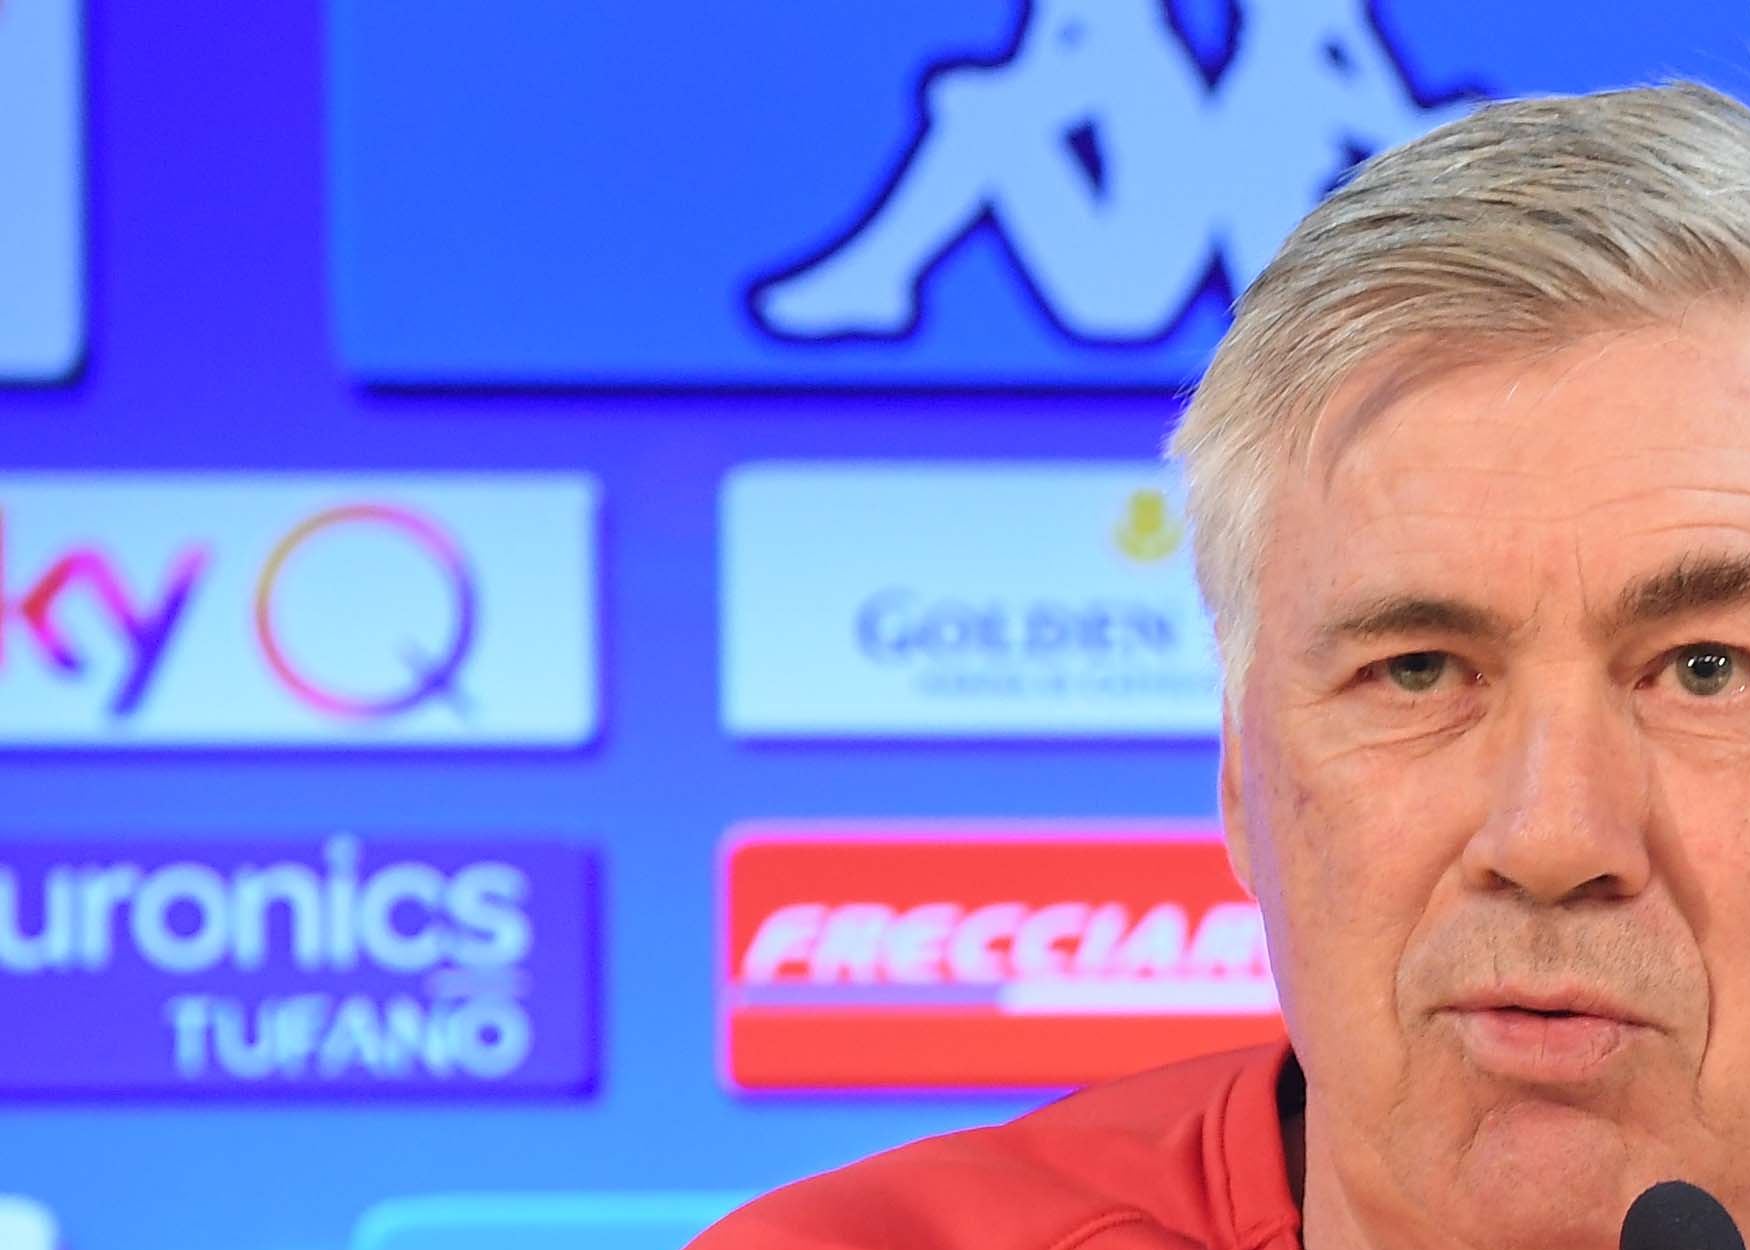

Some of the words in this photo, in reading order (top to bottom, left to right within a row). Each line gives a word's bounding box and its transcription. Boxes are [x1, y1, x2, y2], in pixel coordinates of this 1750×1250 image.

[257, 505, 478, 718] Q
[0, 832, 528, 974] uronics
[172, 992, 528, 1078] TUFANO
